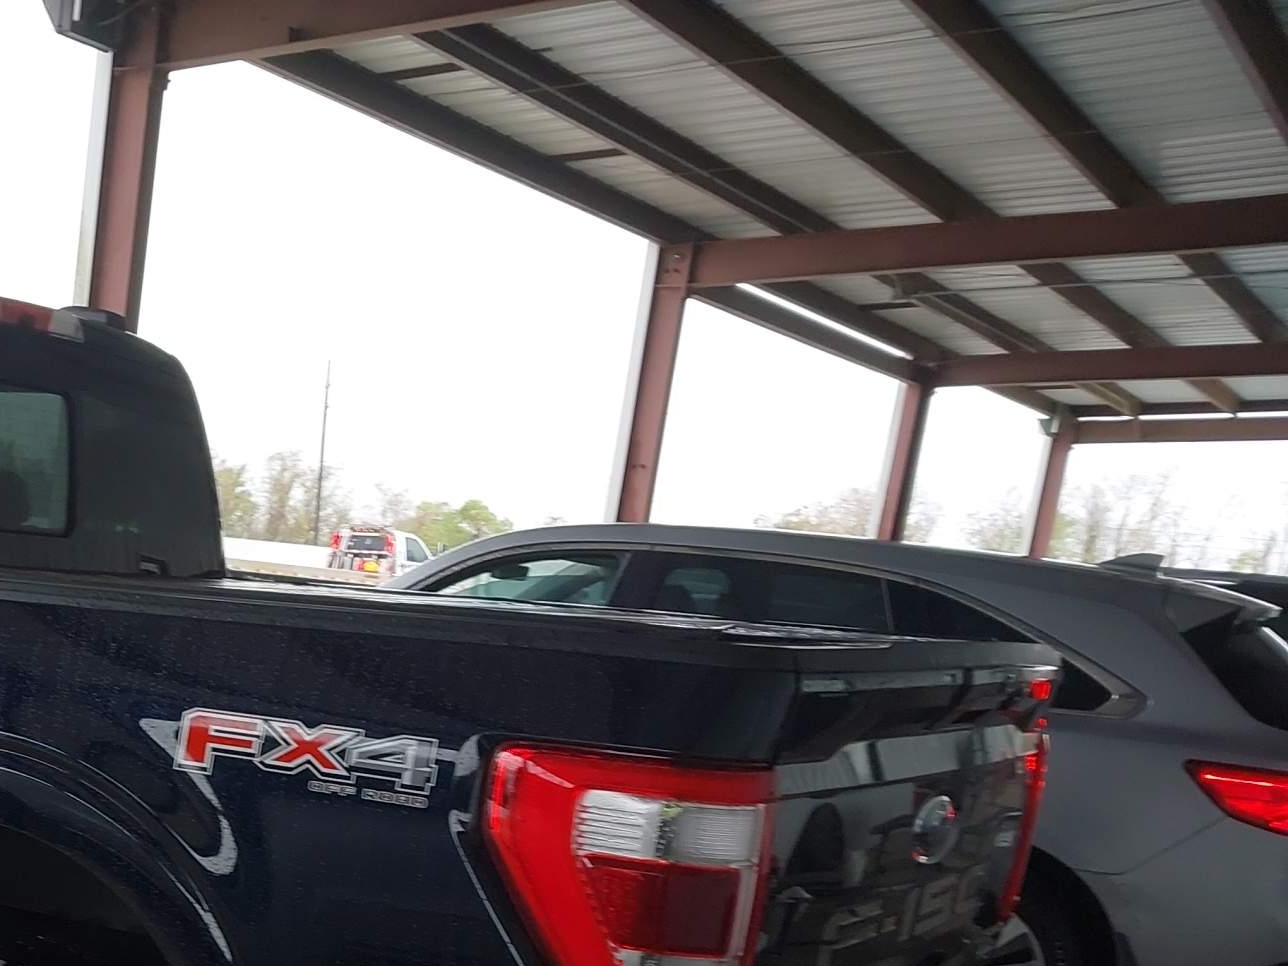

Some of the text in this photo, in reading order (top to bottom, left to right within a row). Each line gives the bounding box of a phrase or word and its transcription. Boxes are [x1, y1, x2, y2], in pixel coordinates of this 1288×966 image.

[173, 707, 440, 795] FX4
[307, 780, 430, 809] OFF ROAD
